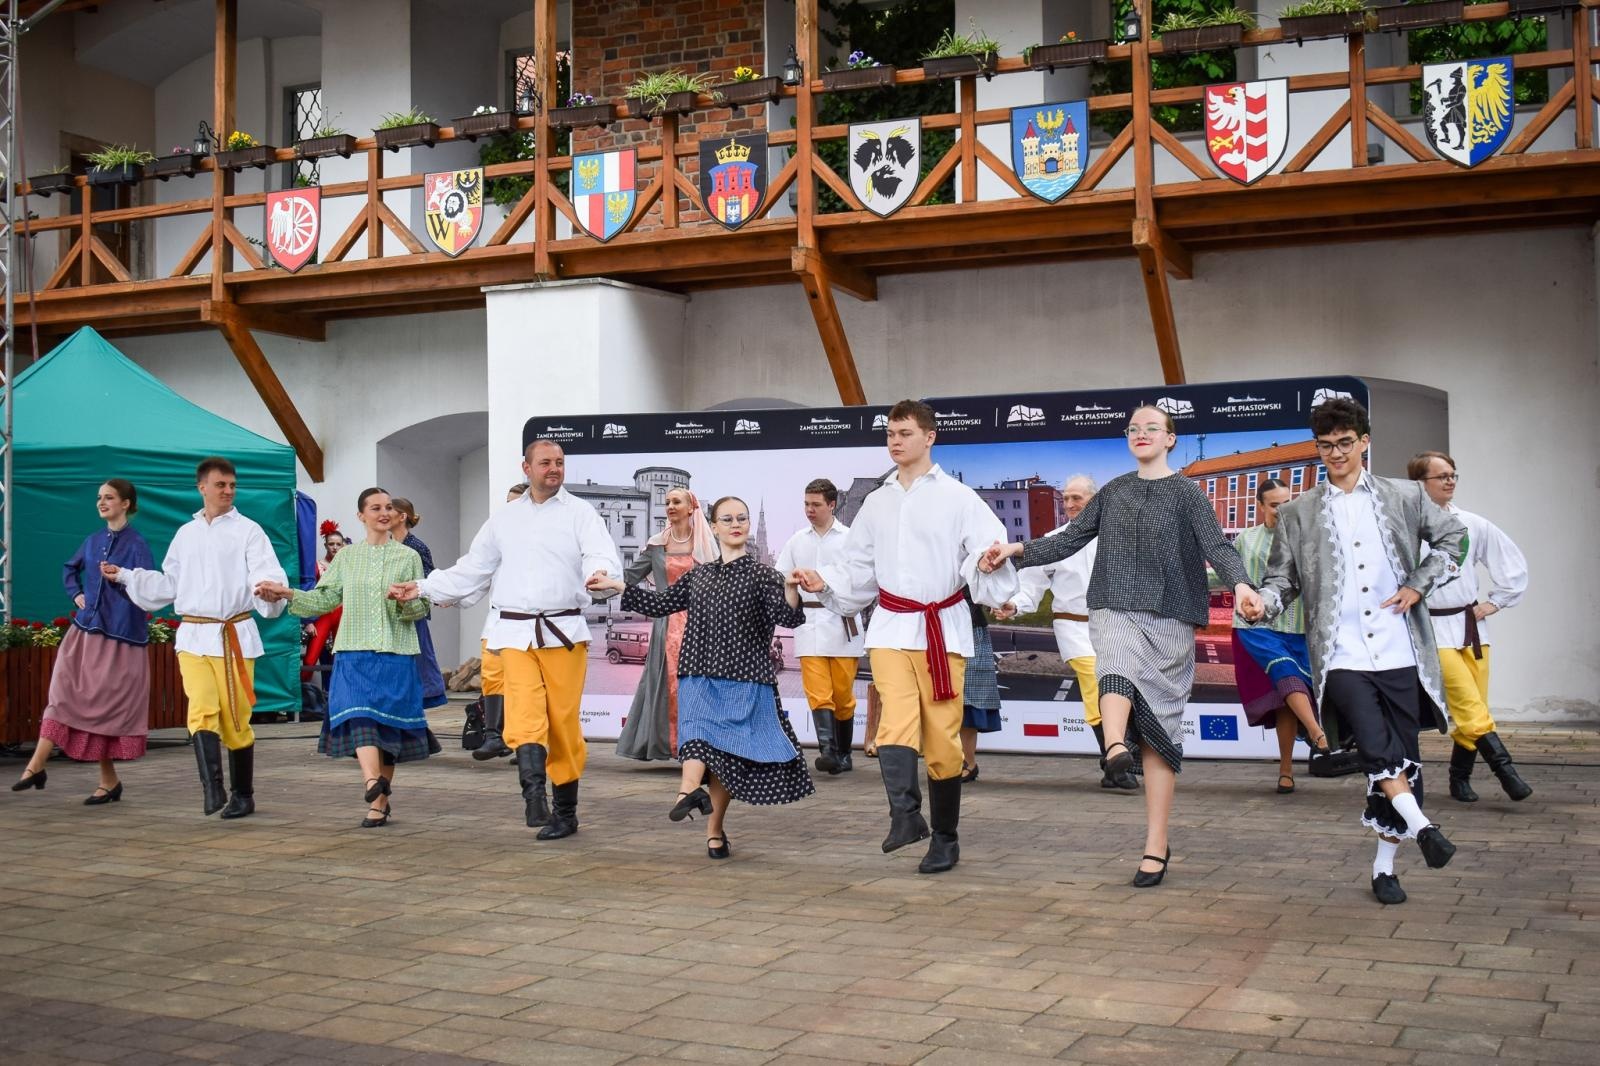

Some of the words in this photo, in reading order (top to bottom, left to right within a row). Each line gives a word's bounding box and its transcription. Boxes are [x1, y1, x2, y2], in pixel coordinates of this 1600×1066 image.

[1212, 405, 1237, 413] ZAMEK
[1238, 403, 1282, 412] PIASTOWSKI
[1085, 412, 1126, 420] PIASTOWSKI
[943, 418, 982, 426] PIASTOWSKI
